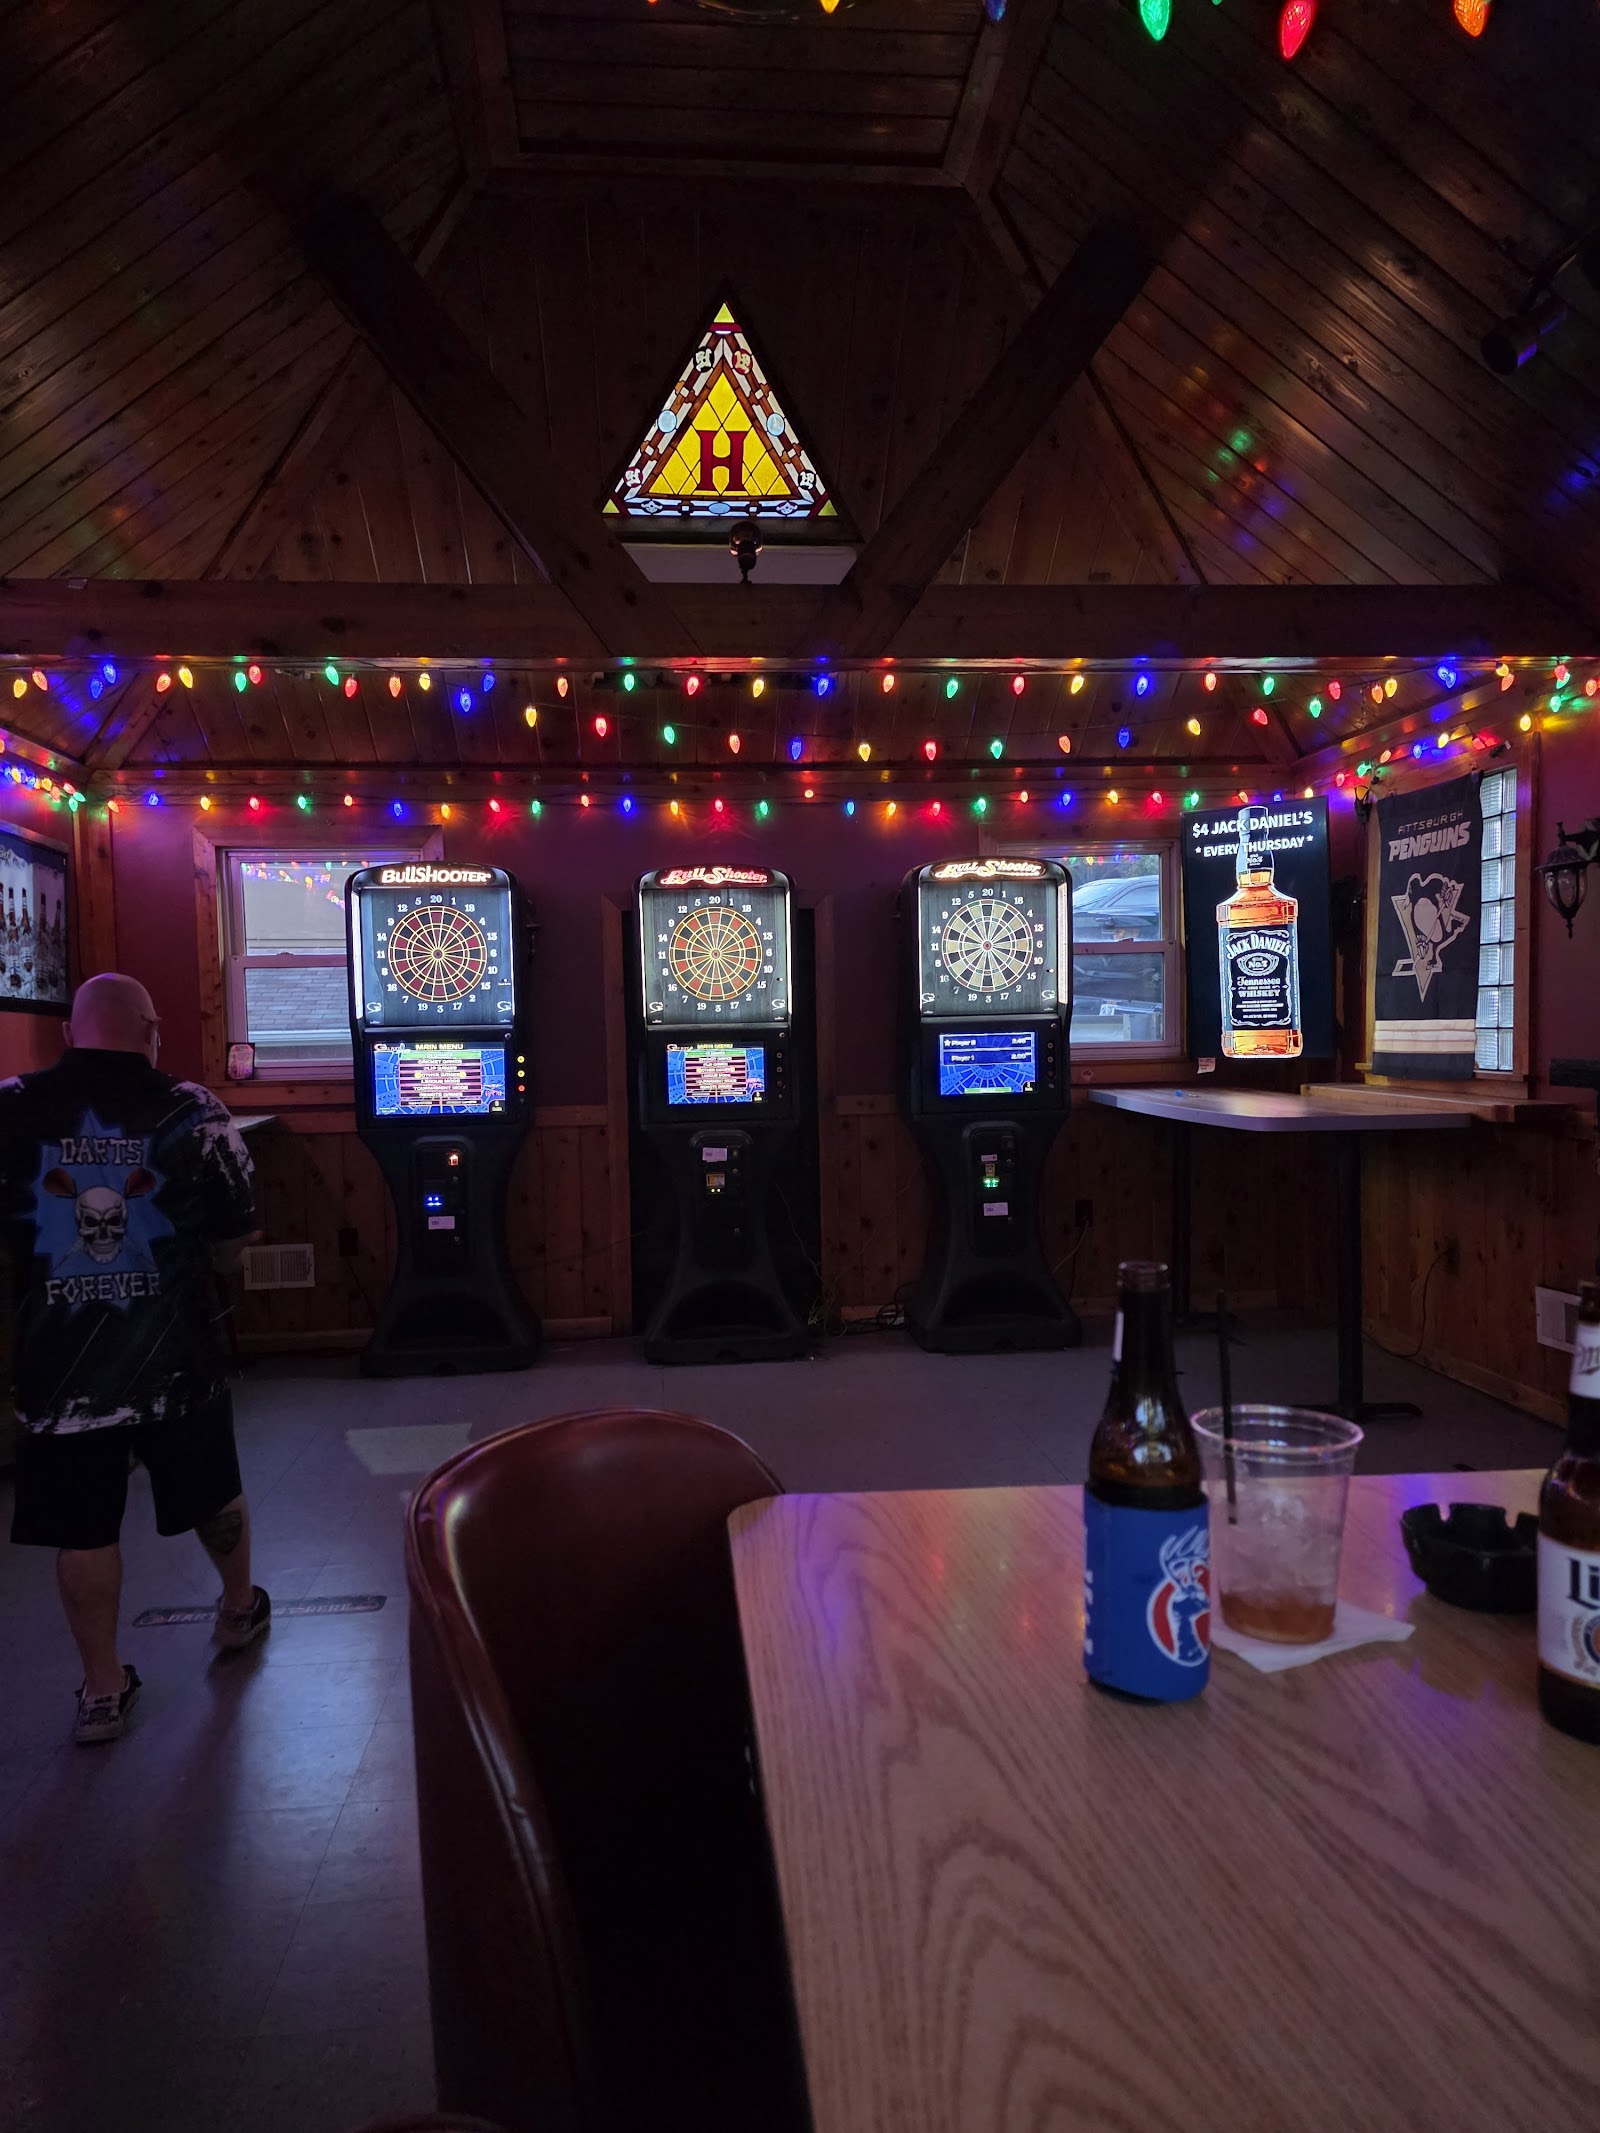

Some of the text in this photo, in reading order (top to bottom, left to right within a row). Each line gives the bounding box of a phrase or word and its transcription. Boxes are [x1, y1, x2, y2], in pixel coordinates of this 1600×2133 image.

[1192, 811, 1313, 838] $4 JACK DANIEL'S
[1388, 821, 1472, 862] PENGUINS
[1204, 836, 1305, 857] EVERY THURSDAY
[977, 861, 1042, 877] Shooter
[704, 867, 768, 884] Shooter
[415, 897, 422, 905] 5
[430, 895, 442, 903] 20
[708, 896, 721, 904] 20
[1014, 897, 1023, 905] 18
[398, 904, 408, 912] 12
[465, 904, 475, 912] 18
[668, 919, 675, 927] 9
[932, 926, 941, 934] 14
[1034, 924, 1044, 932] 13
[377, 933, 387, 941] 14
[763, 932, 773, 940] 13
[1226, 938, 1250, 959] JACK
[490, 949, 497, 957] 6
[381, 968, 388, 976] 8
[488, 966, 498, 974] 10
[662, 968, 669, 976] 8
[1237, 976, 1281, 986] Tennessee
[481, 982, 491, 990] 15
[1000, 992, 1010, 1000] 17
[418, 1003, 428, 1011] 19
[437, 1005, 444, 1013] 3
[59, 1138, 142, 1165] DARTS
[45, 1272, 162, 1306] FOREVER
